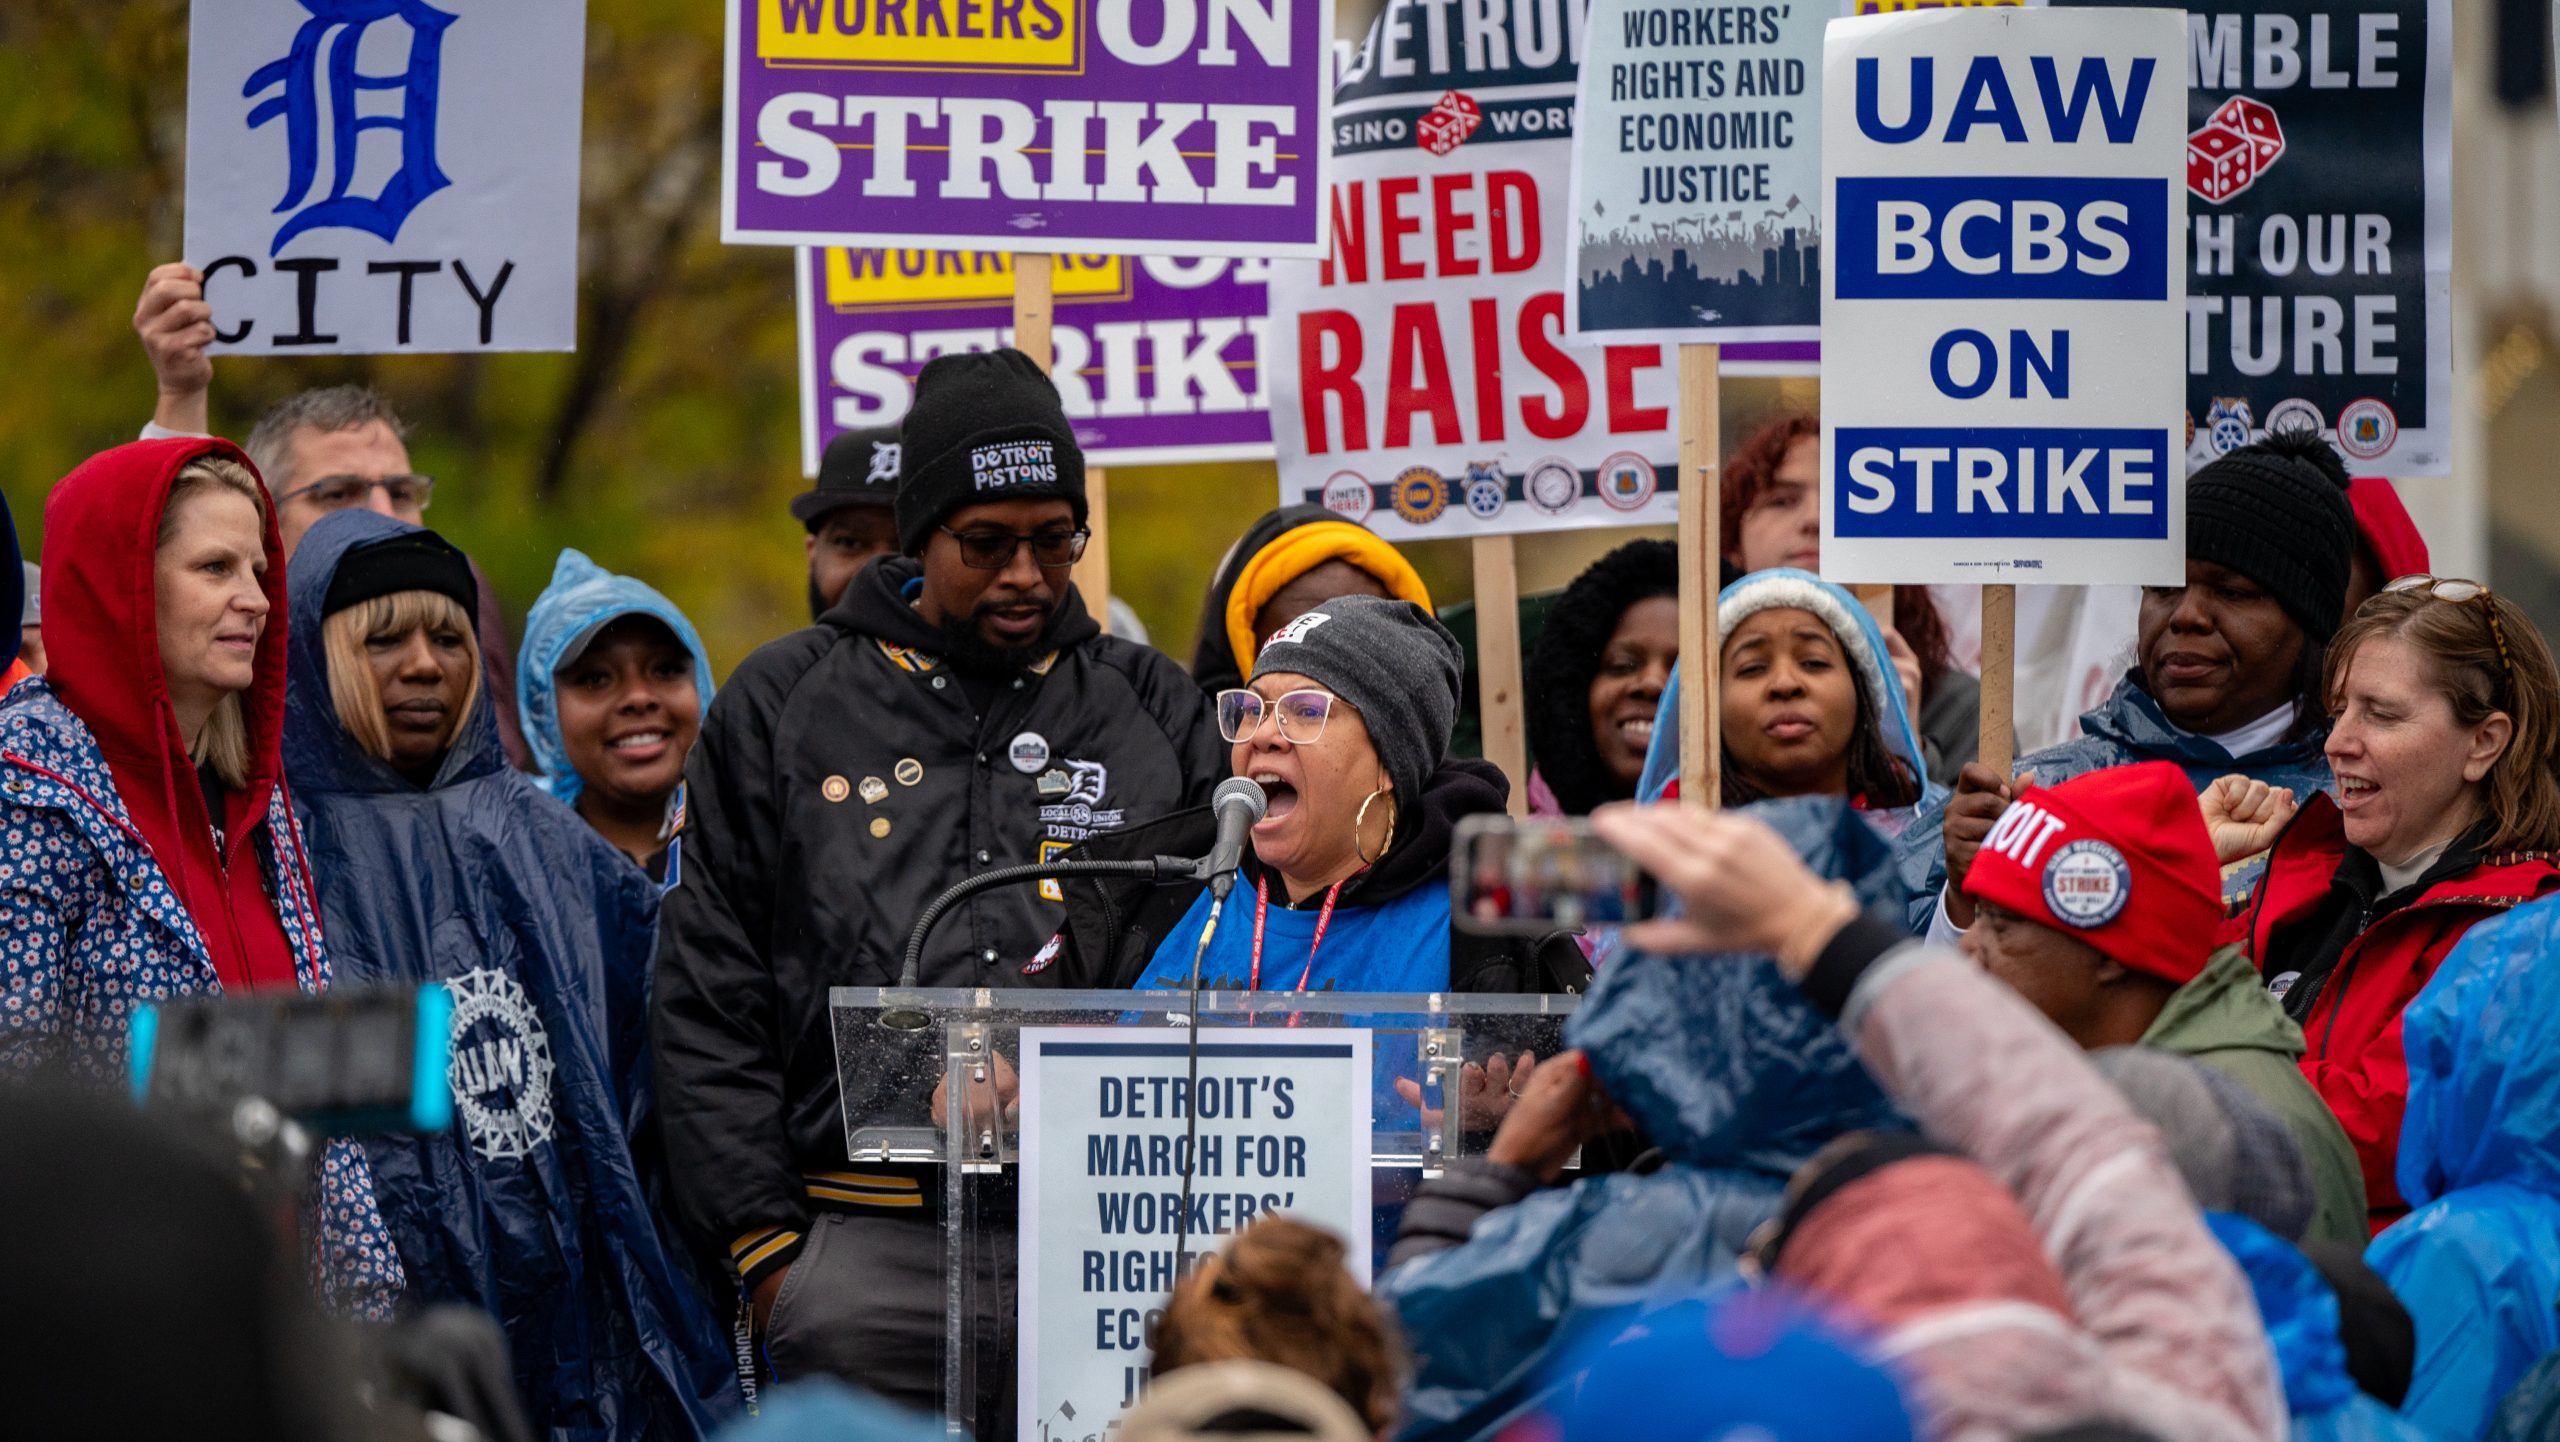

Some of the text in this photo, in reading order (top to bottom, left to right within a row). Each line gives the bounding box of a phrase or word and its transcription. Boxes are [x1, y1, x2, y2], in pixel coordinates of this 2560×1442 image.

[779, 0, 1292, 67] WORKERS ON
[1622, 5, 1791, 48] WORKERS'
[1611, 58, 1805, 101] RIGHTS AND
[1855, 56, 2157, 144] UAW
[756, 91, 1296, 206] STRIKE
[1490, 107, 1575, 133] WOR
[1619, 111, 1793, 153] ECONOMIC
[1639, 164, 1770, 204] JUSTICE
[1319, 169, 1543, 287] NEED
[1877, 199, 2130, 275] BCBS
[2259, 214, 2393, 276] OUR
[199, 255, 515, 346] CITY
[1929, 328, 2070, 400] ON
[2185, 295, 2399, 376] TURE
[1297, 291, 1669, 456] RAISE
[1848, 446, 2154, 515] STRIKE
[1041, 807, 1071, 818] LOCAL
[2058, 877, 2111, 893] STRIKE
[1099, 1075, 1295, 1120] DETROIT'S
[1087, 1134, 1306, 1177] MARCH FOR
